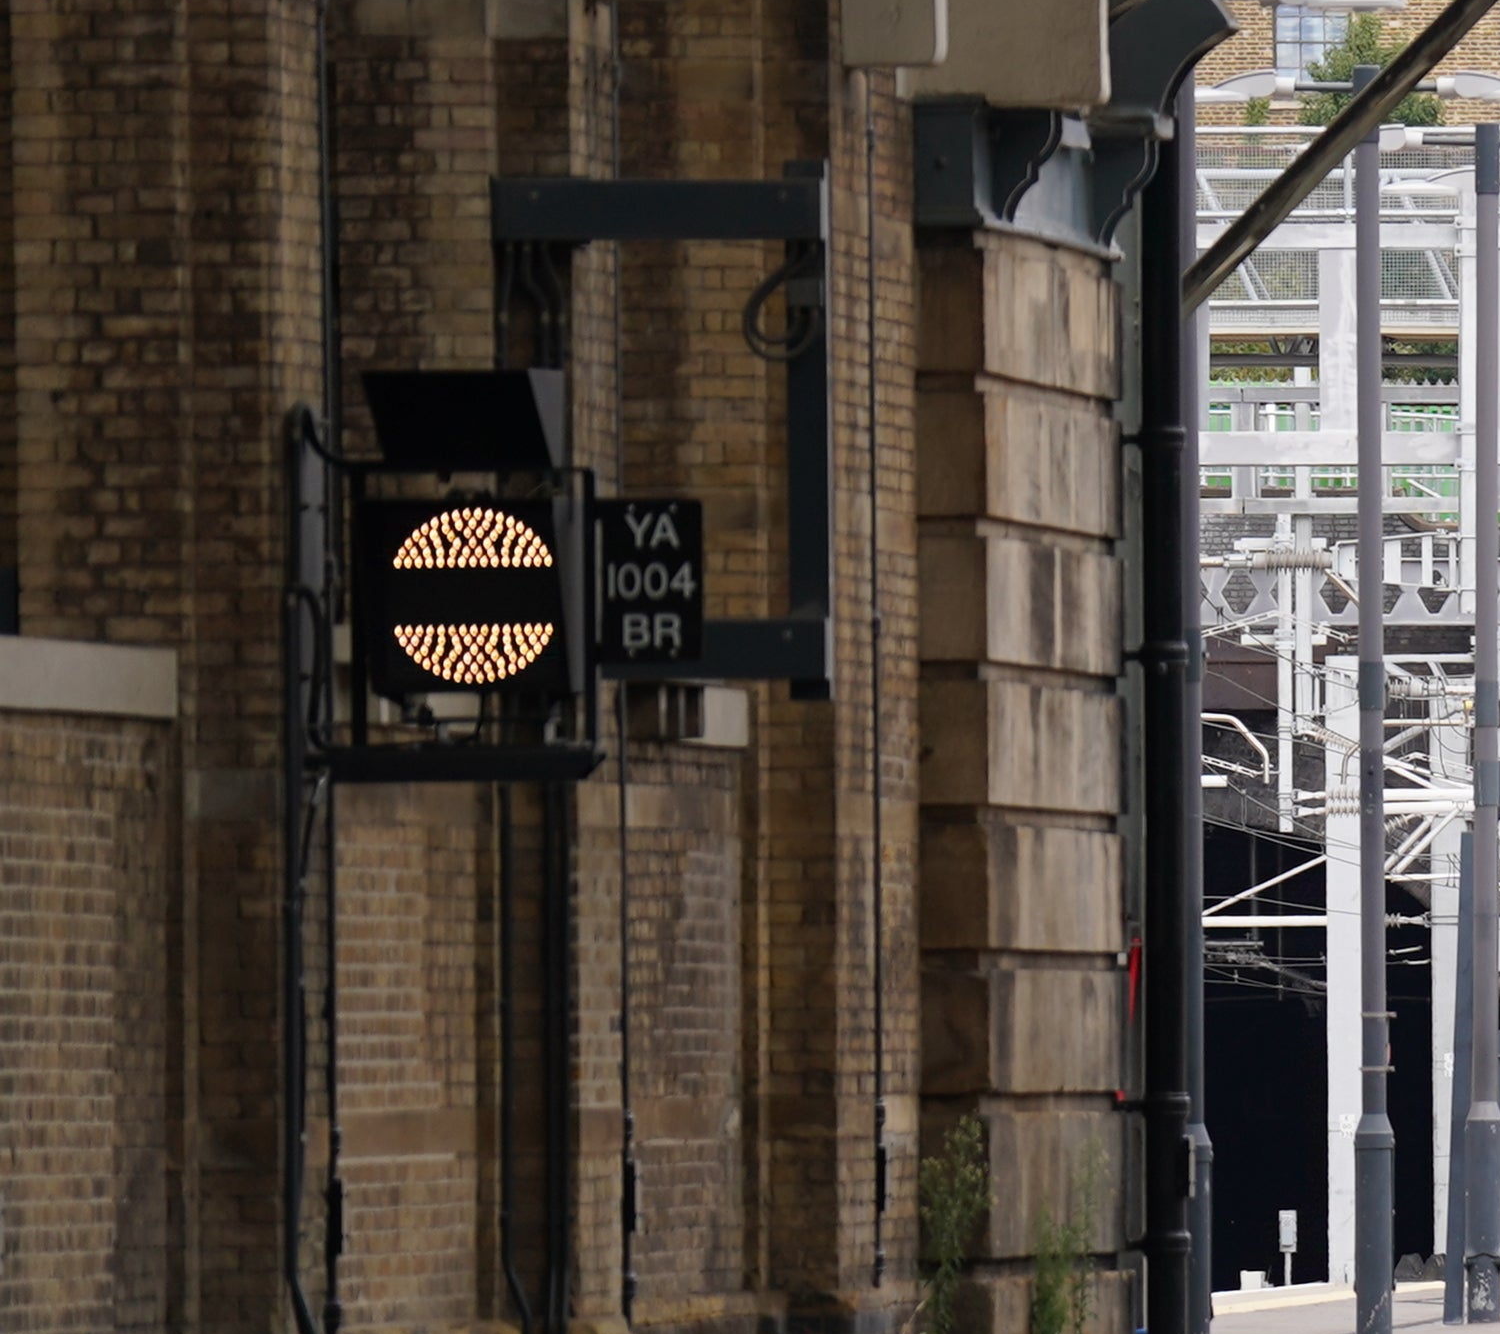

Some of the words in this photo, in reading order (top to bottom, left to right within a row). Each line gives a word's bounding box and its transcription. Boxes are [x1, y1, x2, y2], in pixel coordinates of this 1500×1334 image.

[625, 513, 680, 549] YA
[607, 562, 697, 600] 1004
[622, 613, 682, 648] BR
